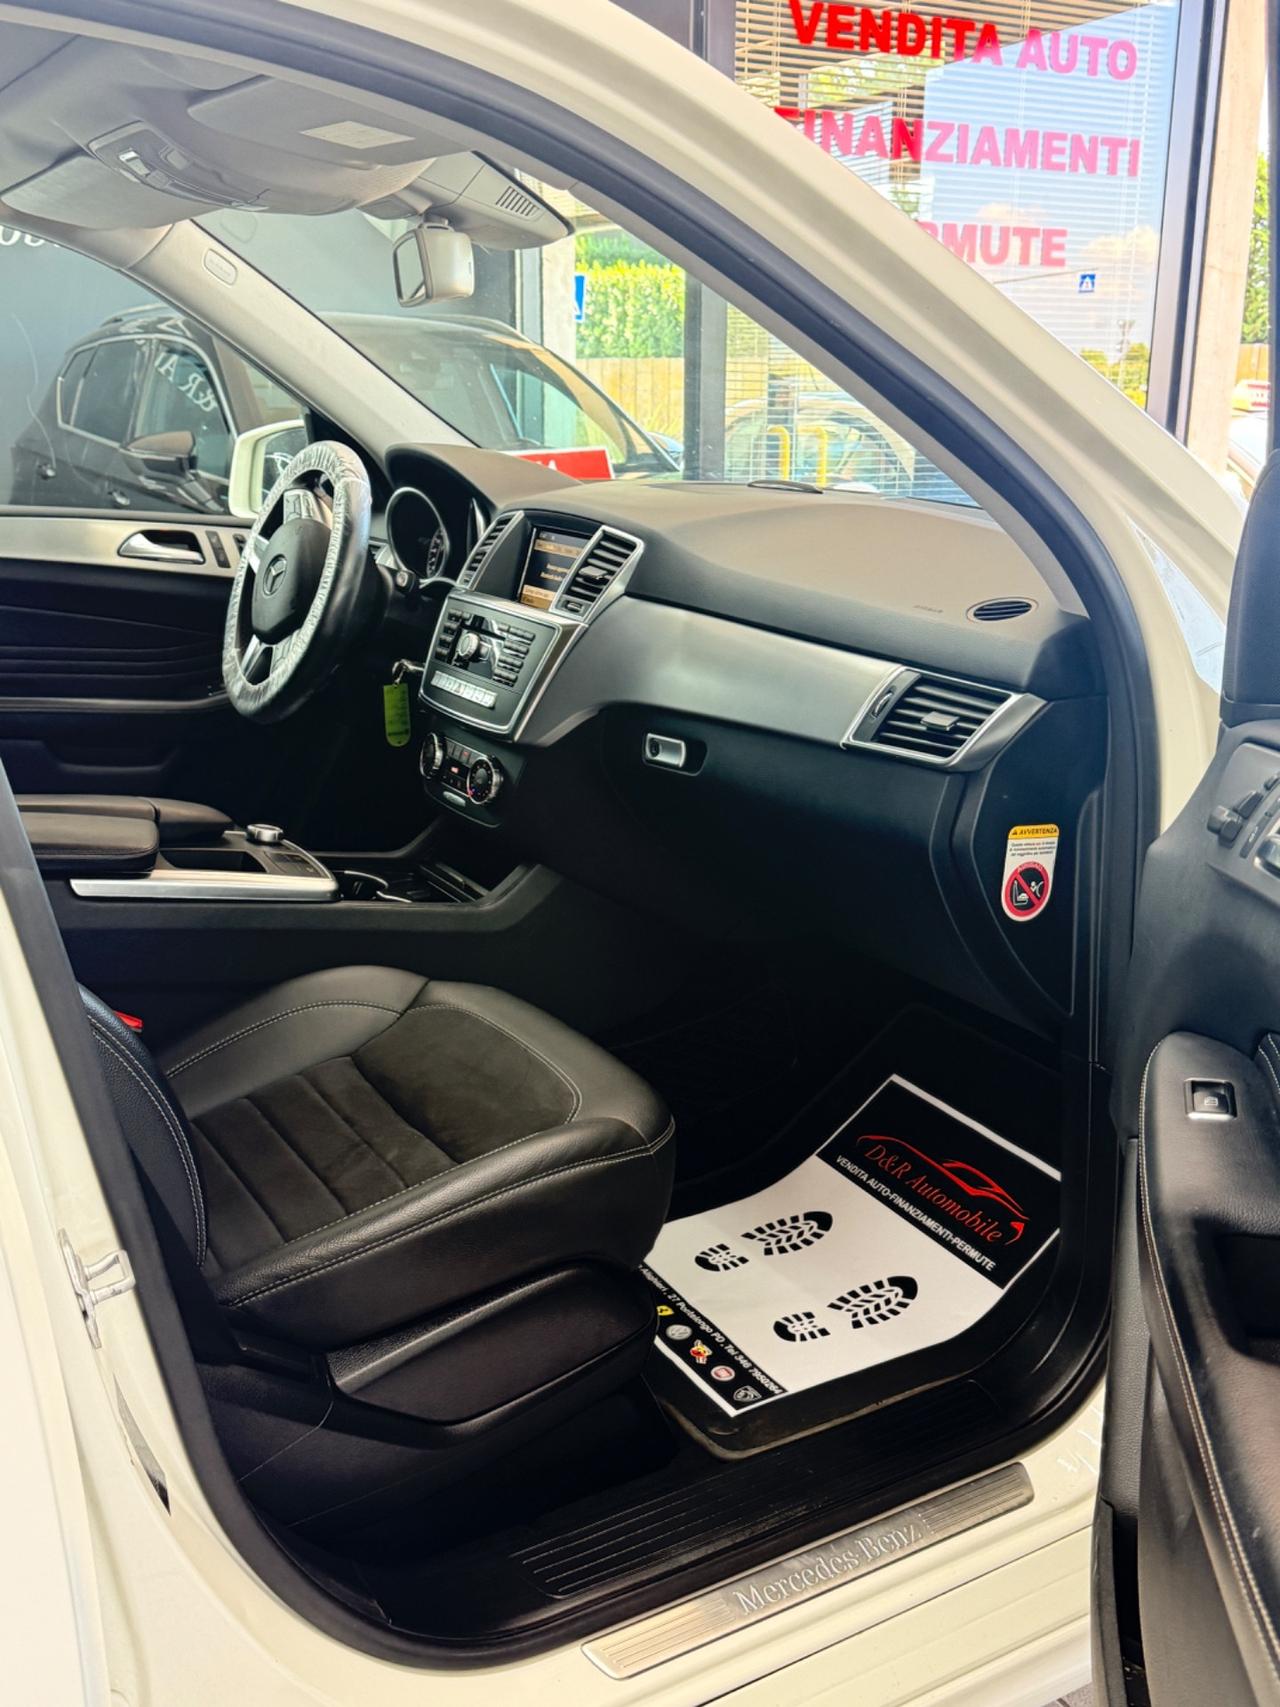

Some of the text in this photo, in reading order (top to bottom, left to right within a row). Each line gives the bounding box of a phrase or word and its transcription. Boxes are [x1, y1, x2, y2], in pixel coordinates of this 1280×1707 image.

[788, 0, 1138, 80] VENDITA AUTO
[836, 1154, 868, 1181] VENDITA
[865, 1144, 1003, 1243] D&R Automobile
